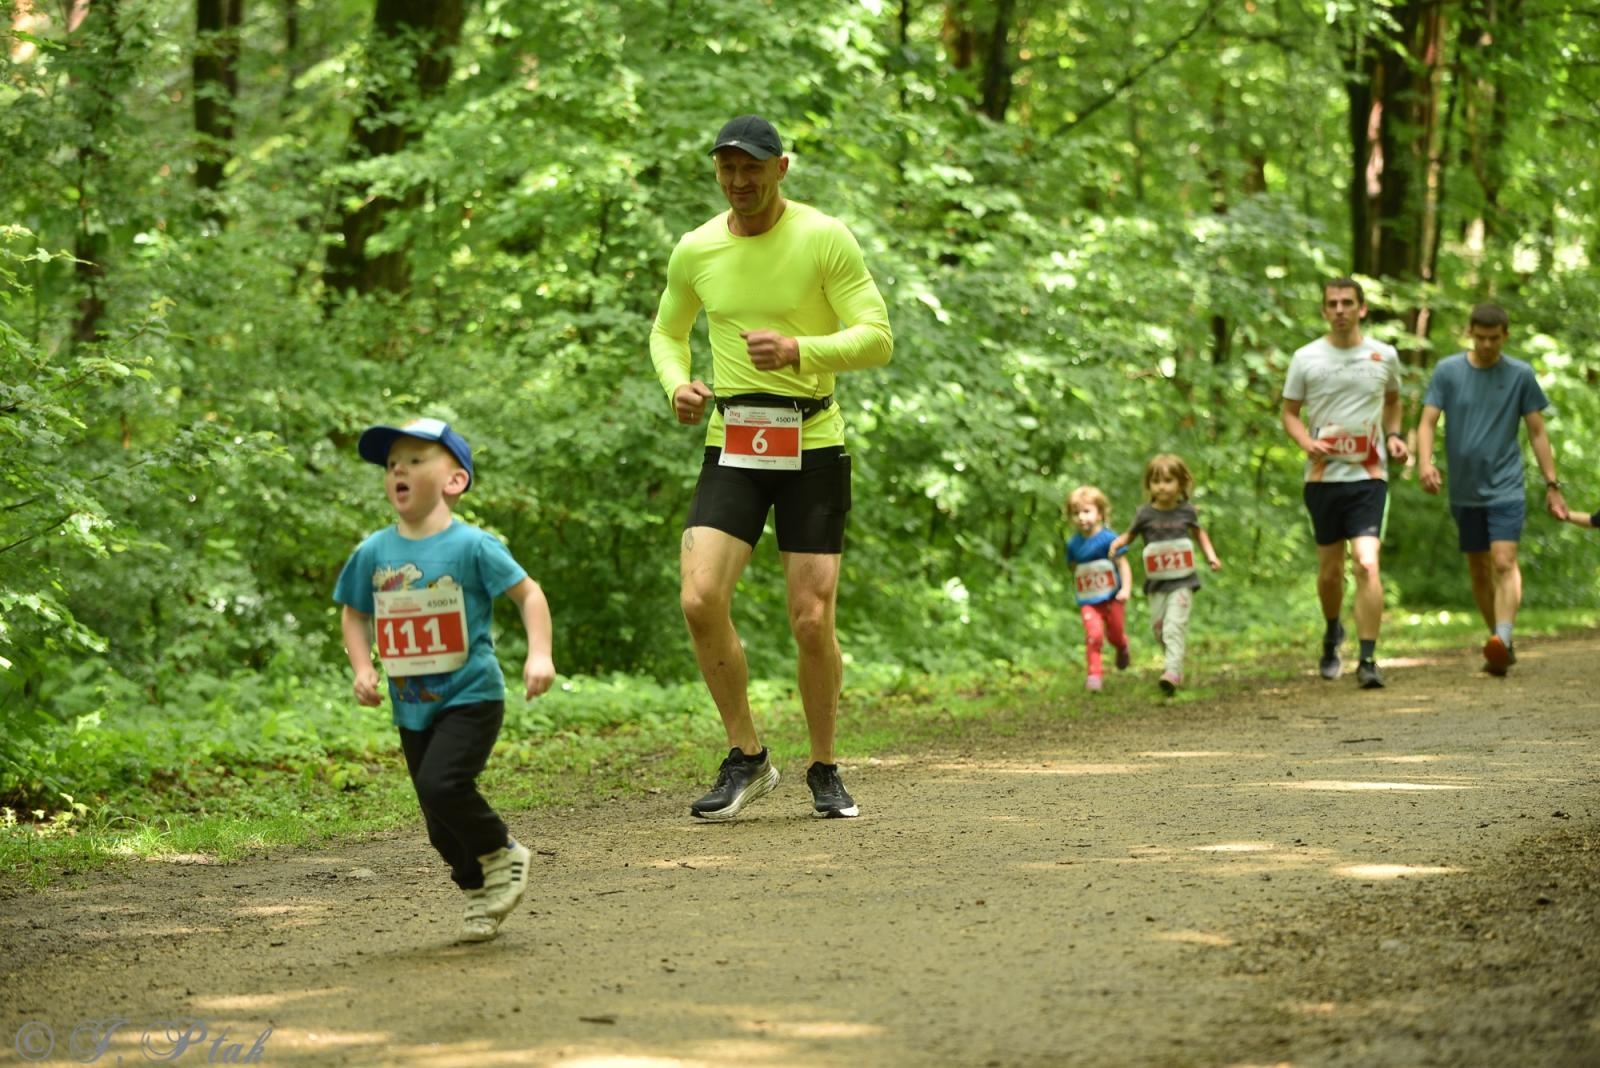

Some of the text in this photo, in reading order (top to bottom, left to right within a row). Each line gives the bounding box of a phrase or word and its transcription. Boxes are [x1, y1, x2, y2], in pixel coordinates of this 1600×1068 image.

[752, 428, 768, 454] 6
[1154, 551, 1188, 573] 121
[1081, 571, 1109, 593] 120
[427, 598, 449, 608] 4500
[450, 597, 459, 605] M
[383, 617, 447, 657] 111
